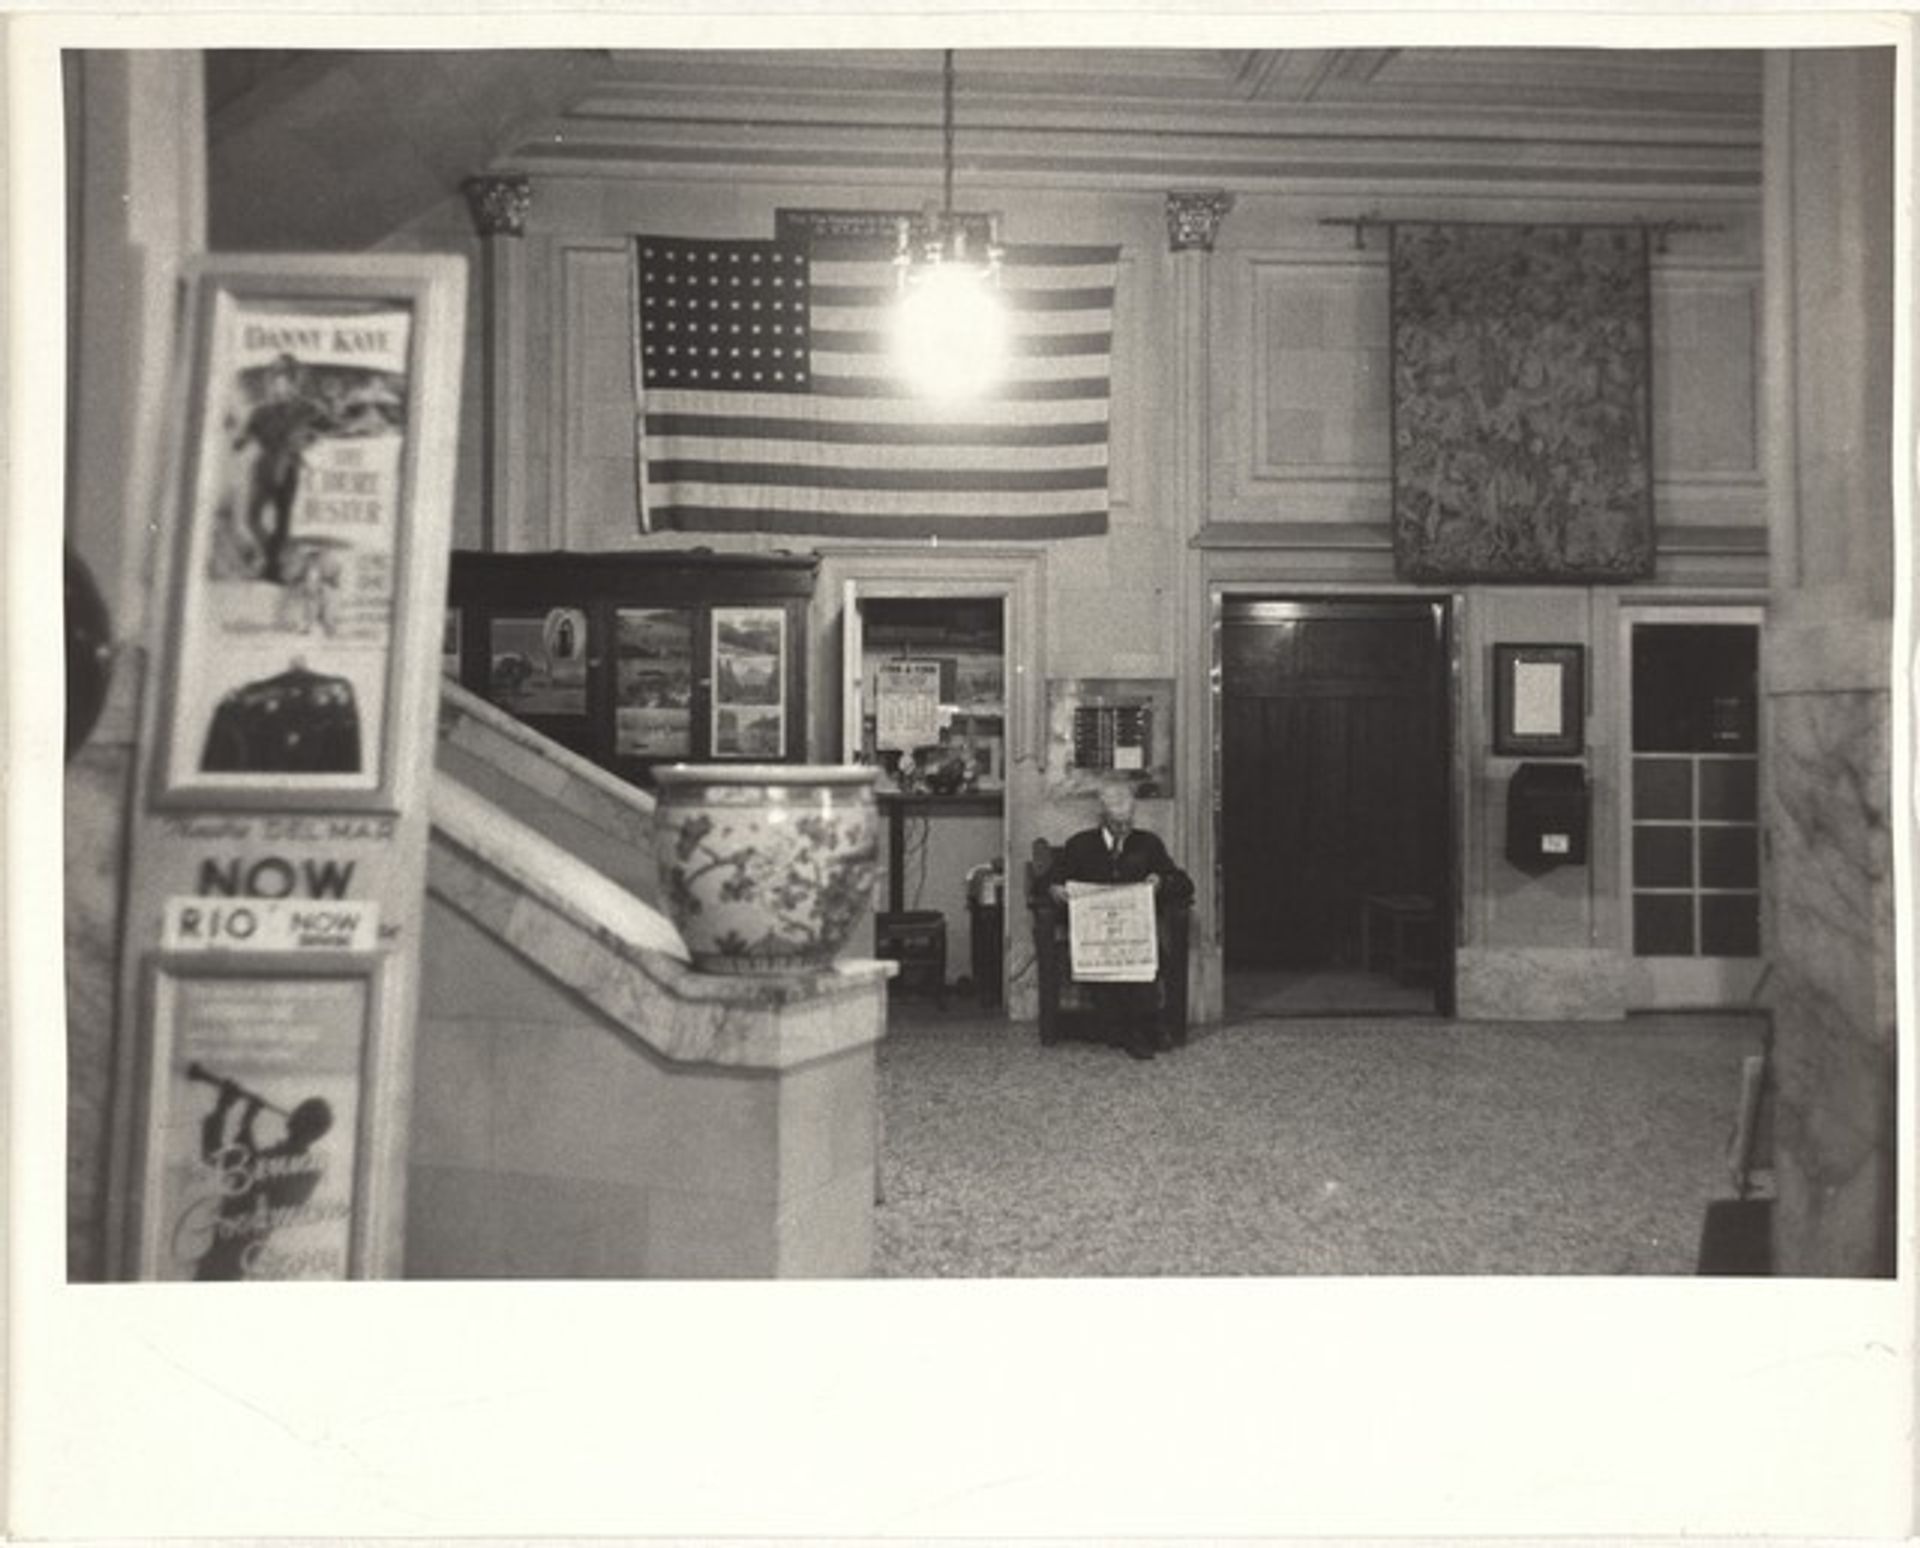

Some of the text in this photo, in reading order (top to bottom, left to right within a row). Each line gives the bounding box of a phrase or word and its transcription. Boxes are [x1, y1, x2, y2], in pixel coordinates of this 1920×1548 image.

[198, 856, 356, 900] NOW
[178, 907, 258, 939] RIO
[290, 911, 361, 933] NOW
